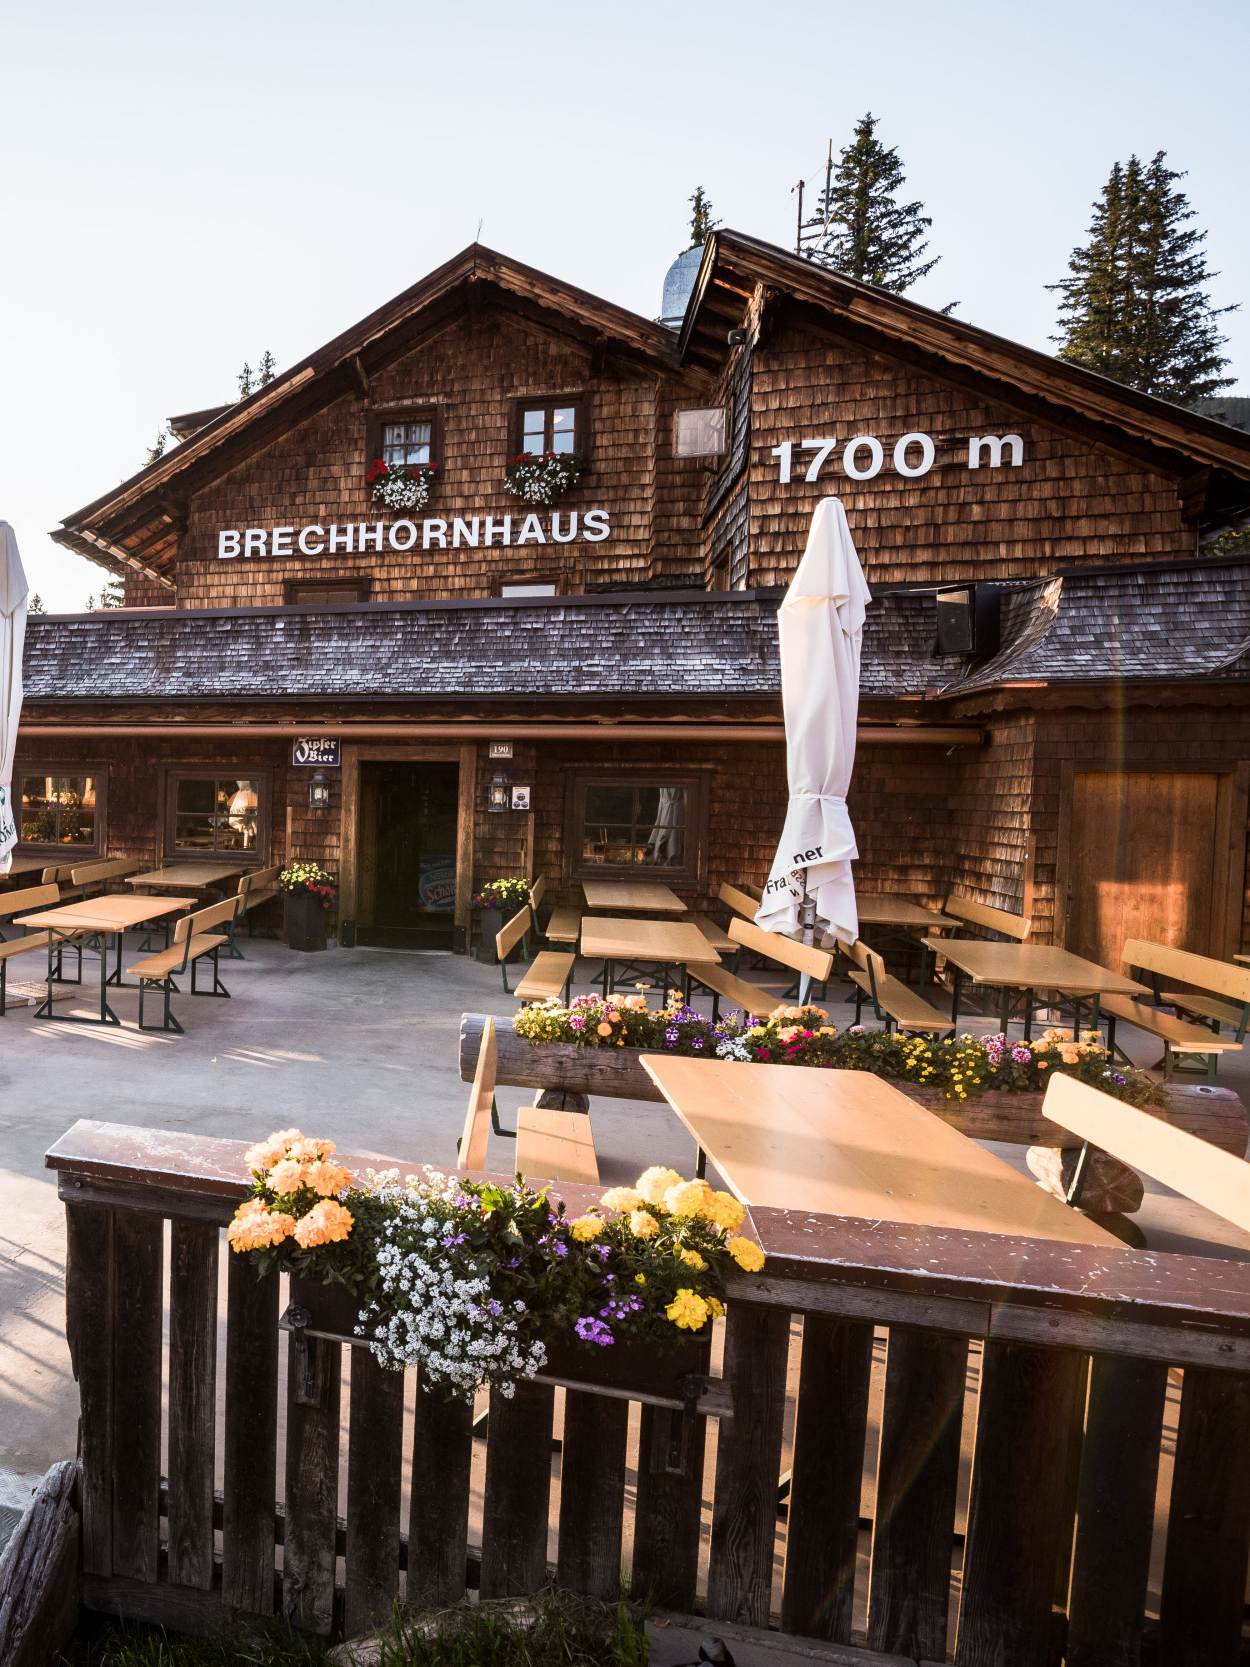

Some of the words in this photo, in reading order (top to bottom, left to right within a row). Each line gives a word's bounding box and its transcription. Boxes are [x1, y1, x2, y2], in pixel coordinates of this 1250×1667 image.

[771, 432, 935, 484] 1700
[968, 433, 1024, 469] m
[218, 509, 611, 559] BRECHHORNHAUS
[296, 738, 336, 762] Zipfer
[308, 750, 334, 762] Bier
[493, 745, 509, 754] 190
